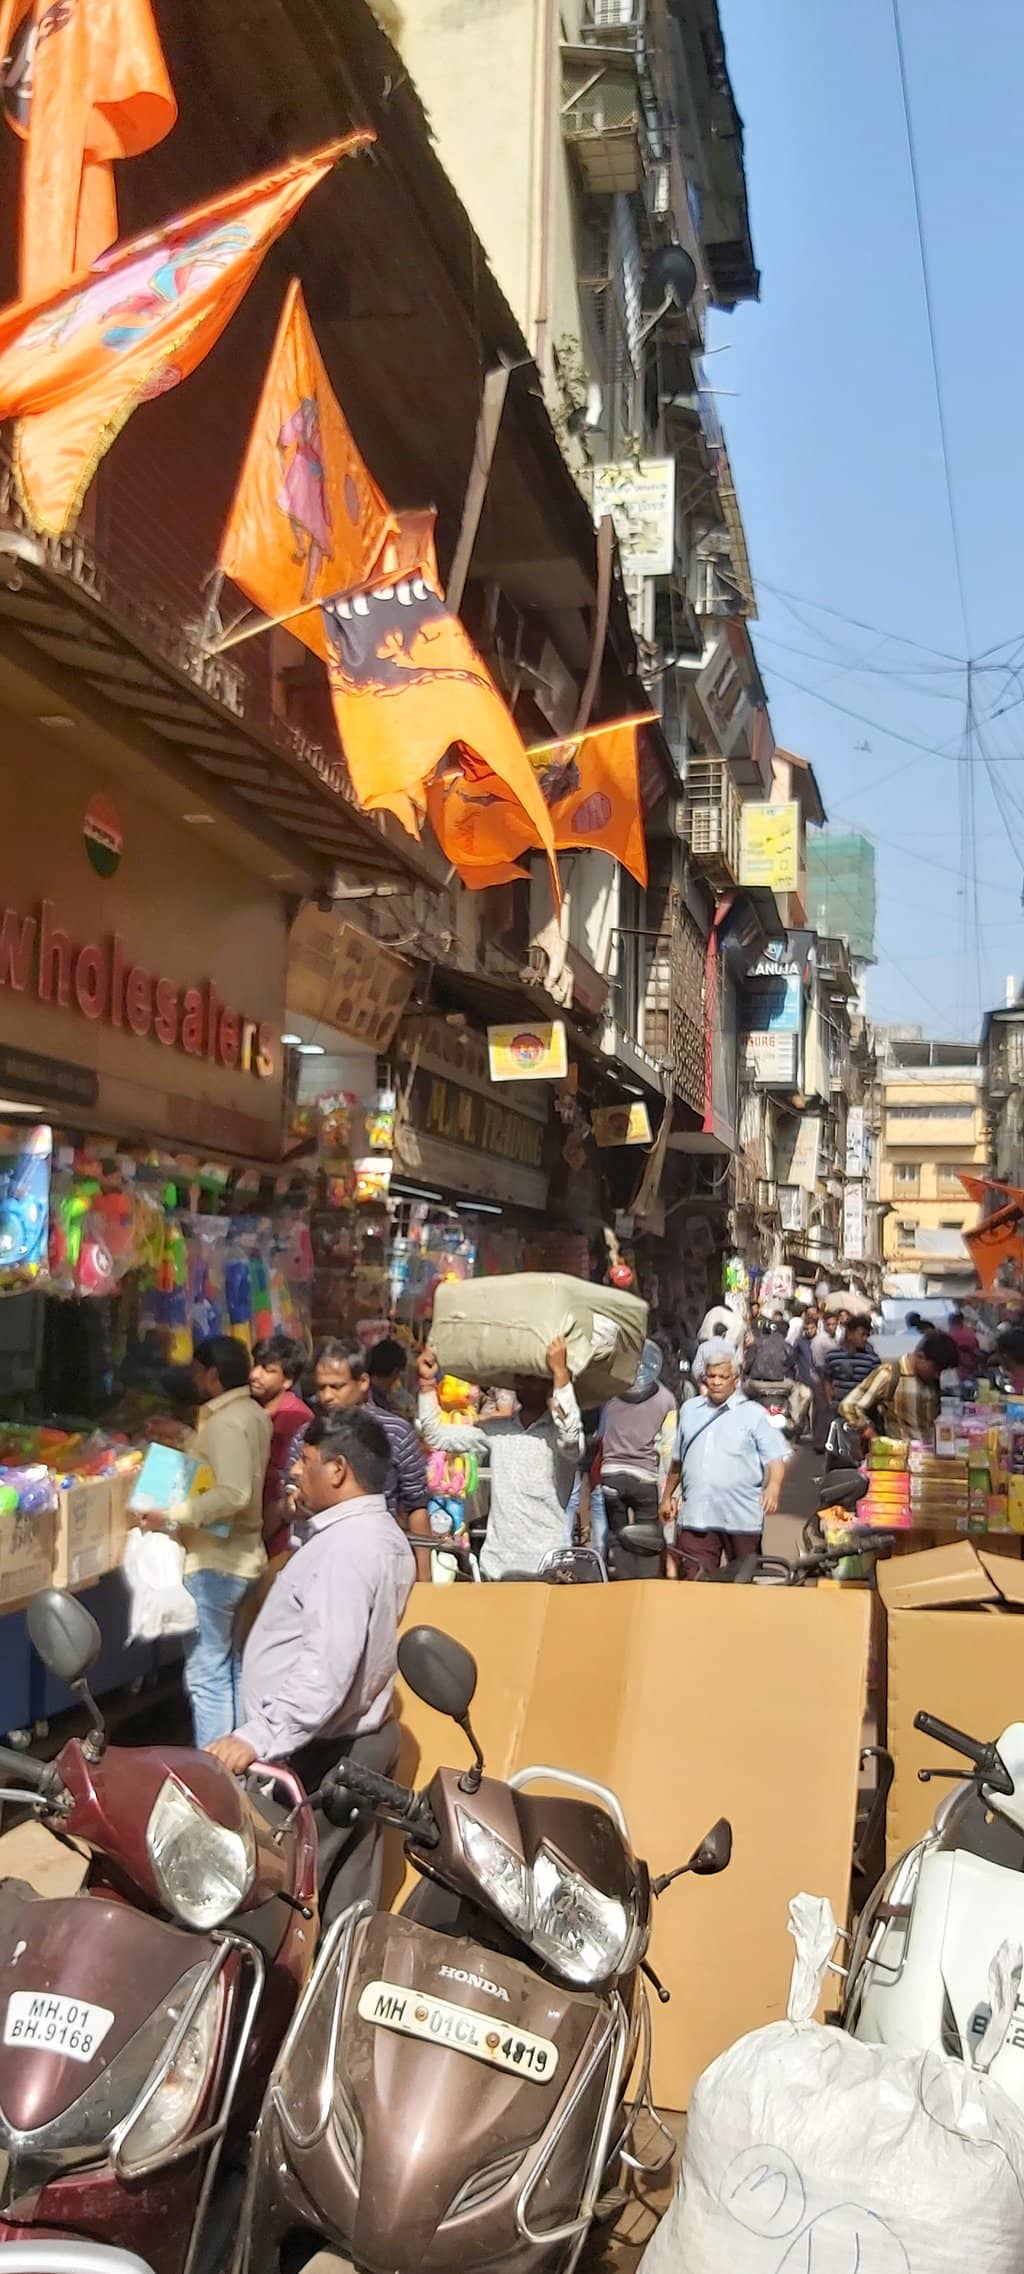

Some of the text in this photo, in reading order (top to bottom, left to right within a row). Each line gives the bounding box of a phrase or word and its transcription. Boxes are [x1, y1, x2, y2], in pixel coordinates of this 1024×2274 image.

[0, 900, 274, 1077] wholesalers
[439, 1965, 510, 2002] HONDA
[28, 1999, 89, 2028] MH.01
[374, 1995, 407, 2022] MH
[429, 2010, 479, 2046] 01CL
[11, 2019, 93, 2053] BH.9168
